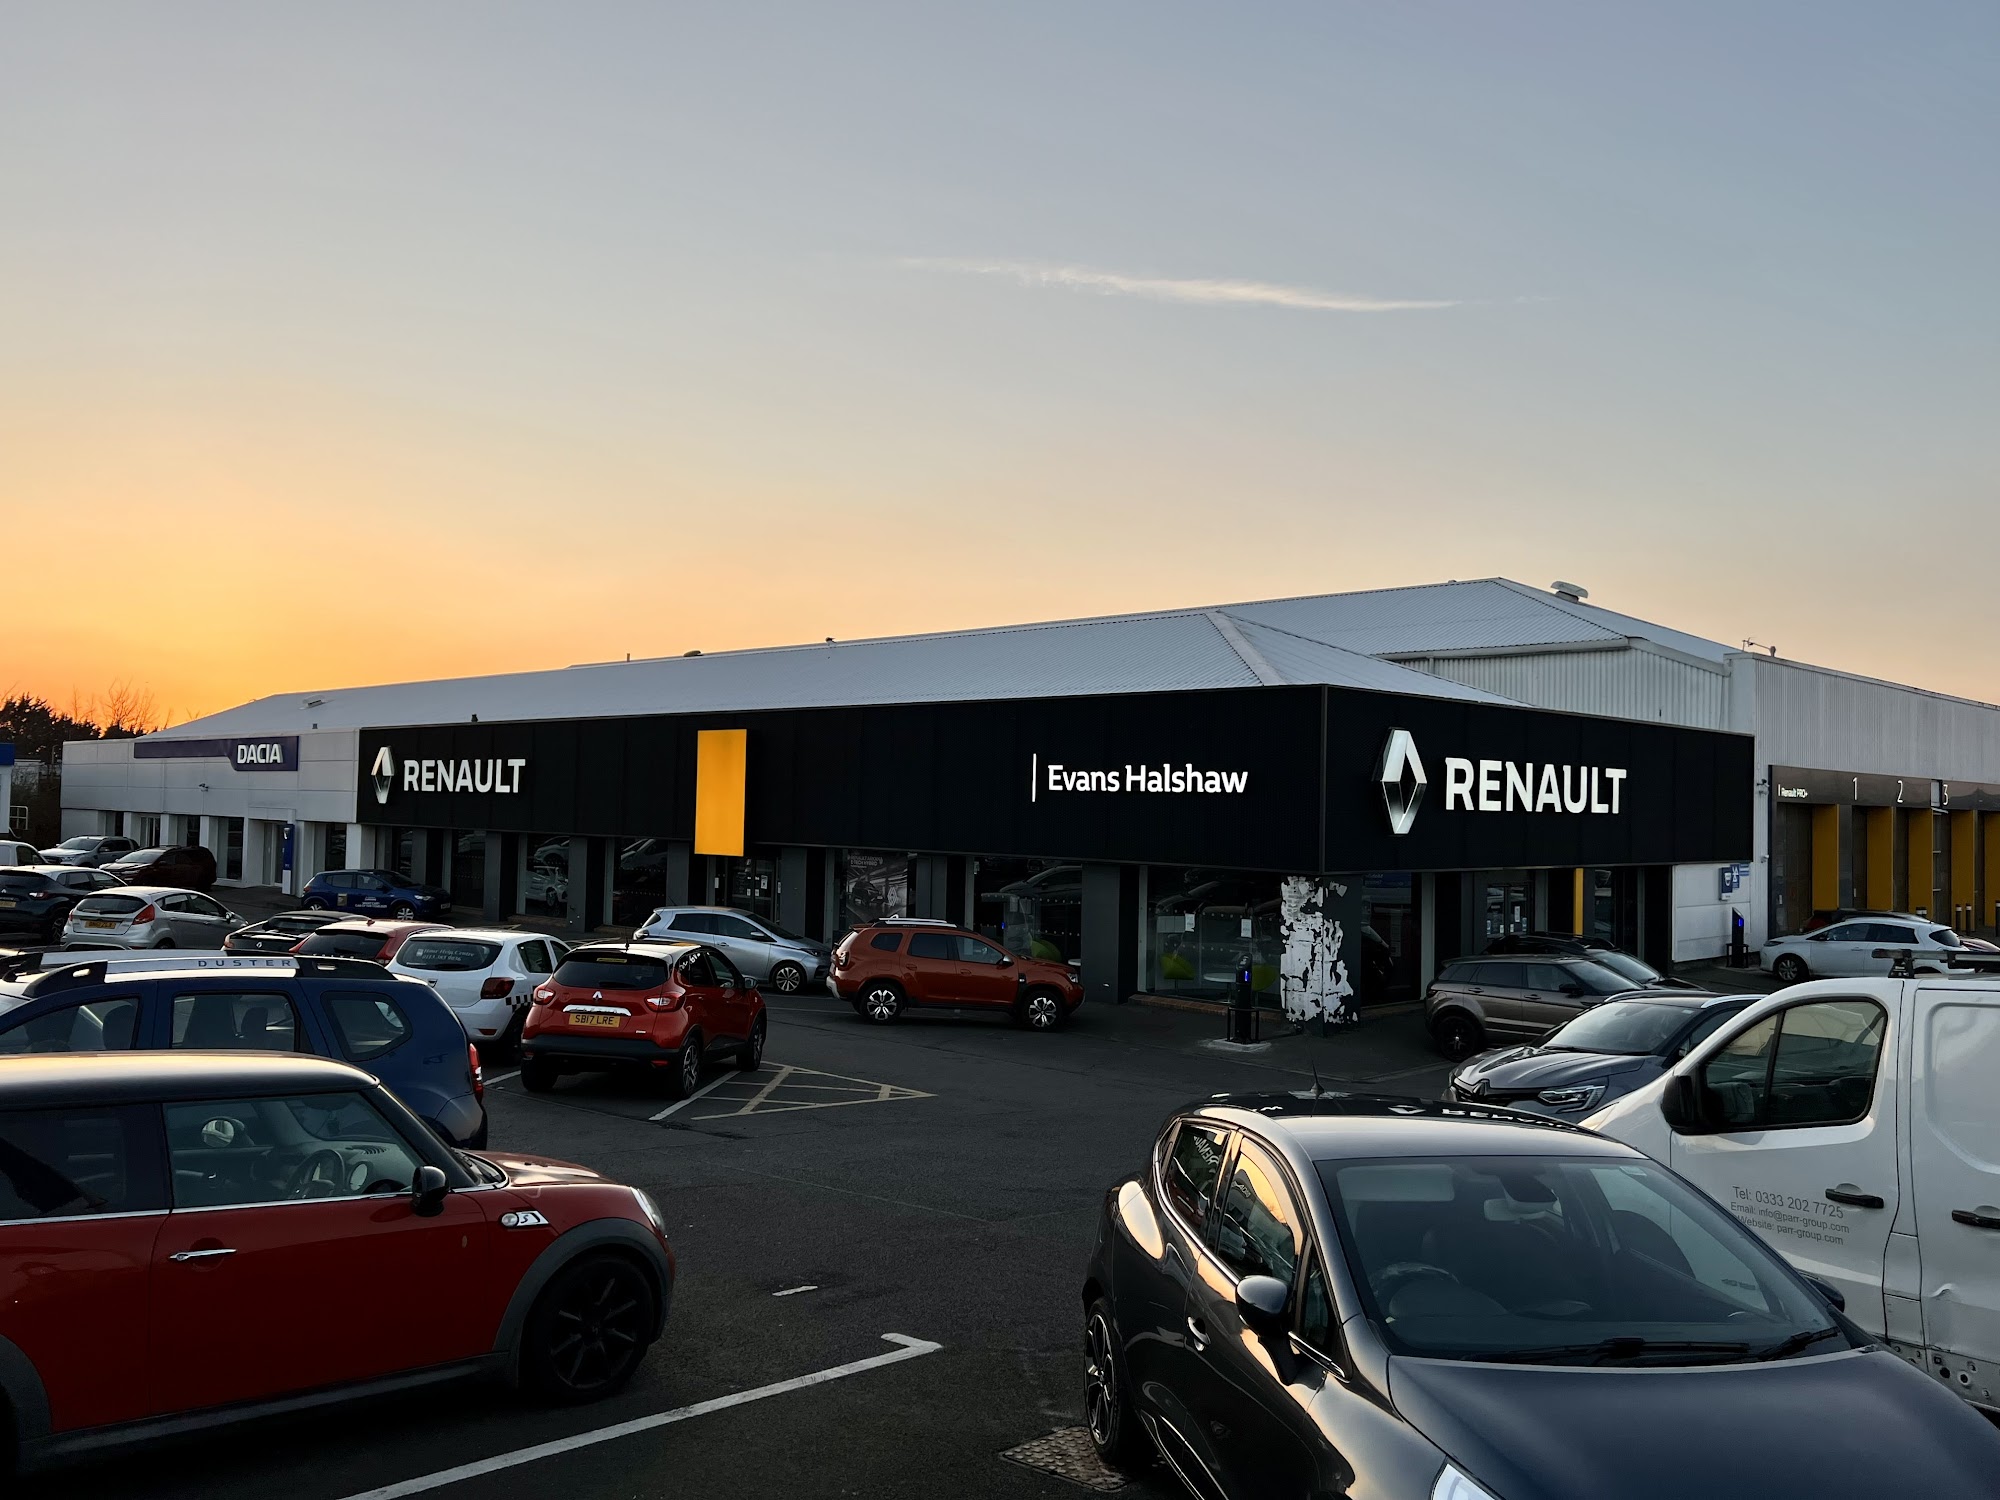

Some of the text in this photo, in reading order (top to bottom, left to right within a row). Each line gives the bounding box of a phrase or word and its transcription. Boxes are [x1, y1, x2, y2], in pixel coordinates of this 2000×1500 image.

[237, 743, 283, 764] DACIA
[403, 758, 526, 793] RENAULT
[1048, 763, 1249, 793] Evans Halshaw
[1445, 757, 1627, 814] RENAULT
[1852, 777, 1858, 800] 1
[1897, 780, 1904, 803] 2
[1943, 784, 1949, 806] 3
[198, 959, 292, 967] DUSTER
[575, 1014, 615, 1025] SB17 LRE
[1732, 1185, 1844, 1219] Tel: 0333 202 7725
[520, 1214, 529, 1224] S
[1730, 1202, 1850, 1234] Email: info@parr-group.com
[1737, 1215, 1844, 1245] Website: parr-group.com
